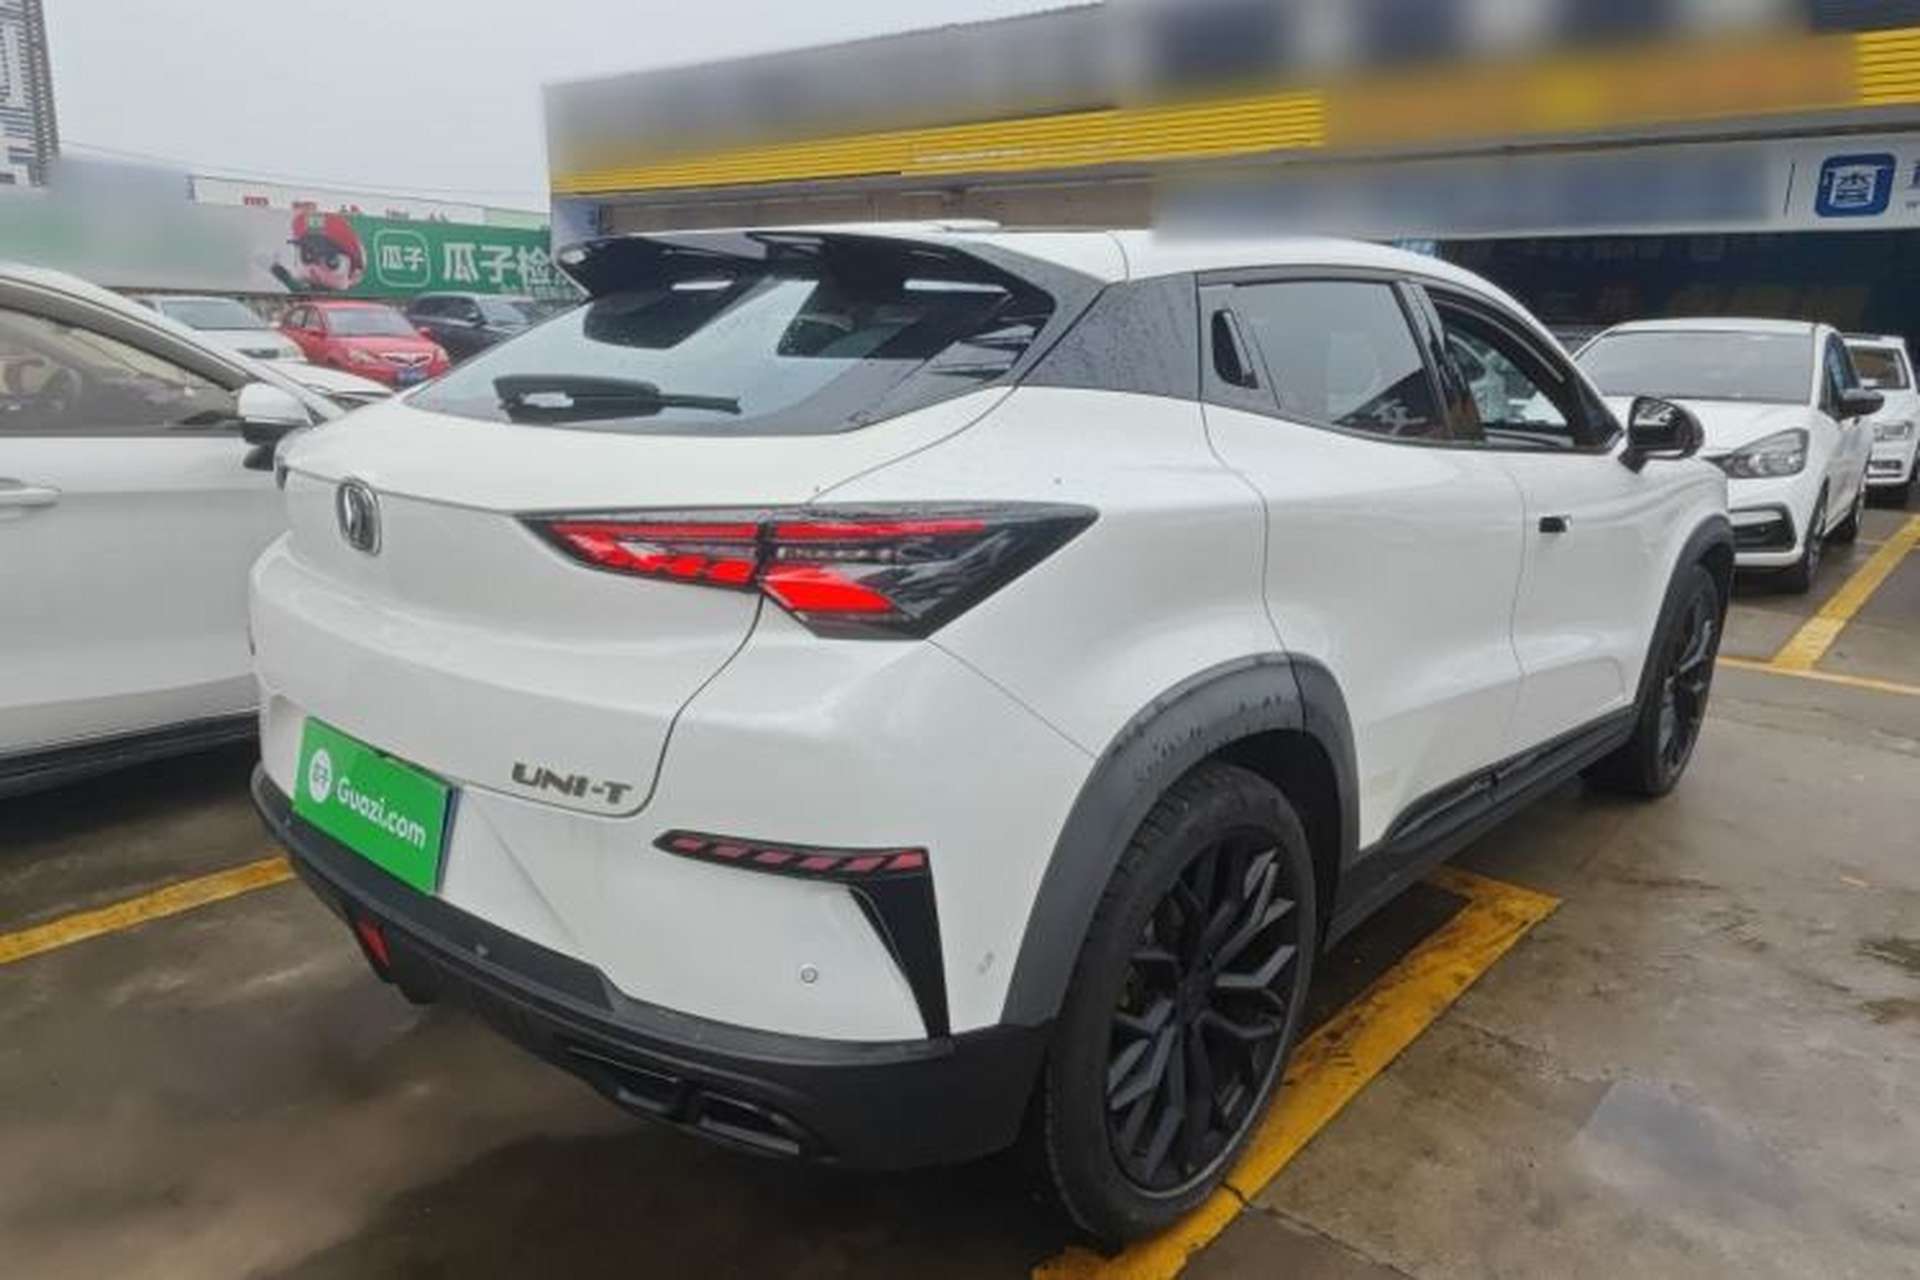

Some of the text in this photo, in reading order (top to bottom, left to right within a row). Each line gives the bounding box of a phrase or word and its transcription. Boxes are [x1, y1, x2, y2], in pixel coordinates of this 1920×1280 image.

[382, 245, 424, 271] 瓜子
[443, 242, 566, 288] 瓜子检
[512, 762, 632, 804] UNI-T
[337, 776, 427, 851] Guazi.com
